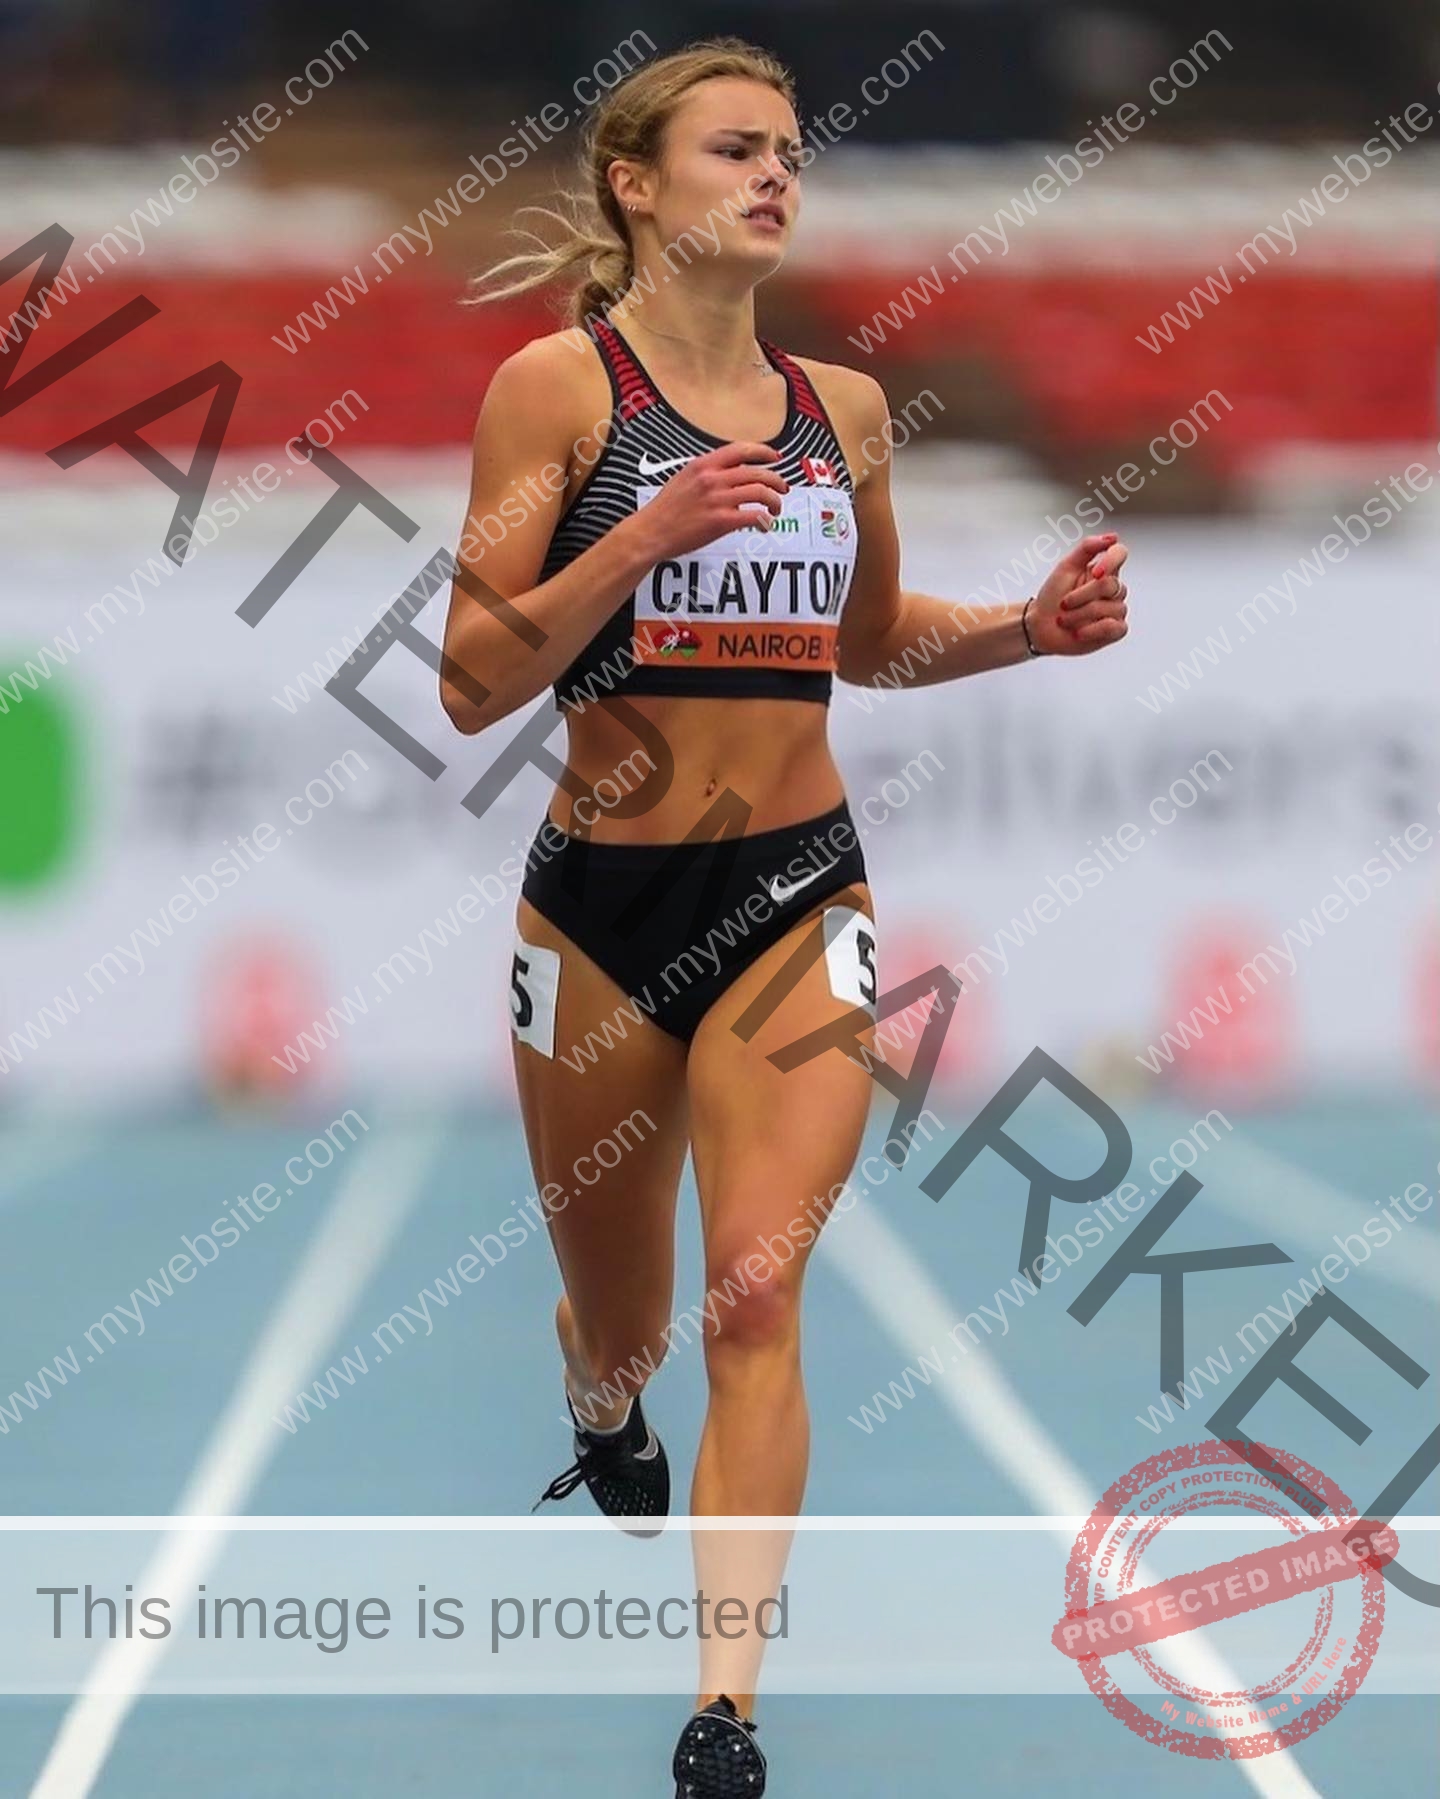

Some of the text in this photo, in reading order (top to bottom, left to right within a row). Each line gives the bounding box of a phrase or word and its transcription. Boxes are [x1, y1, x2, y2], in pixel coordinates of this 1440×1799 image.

[652, 561, 848, 616] CLAYTON
[717, 634, 831, 660] NAIROB
[511, 952, 533, 1027] 5
[856, 929, 876, 1005] 5
